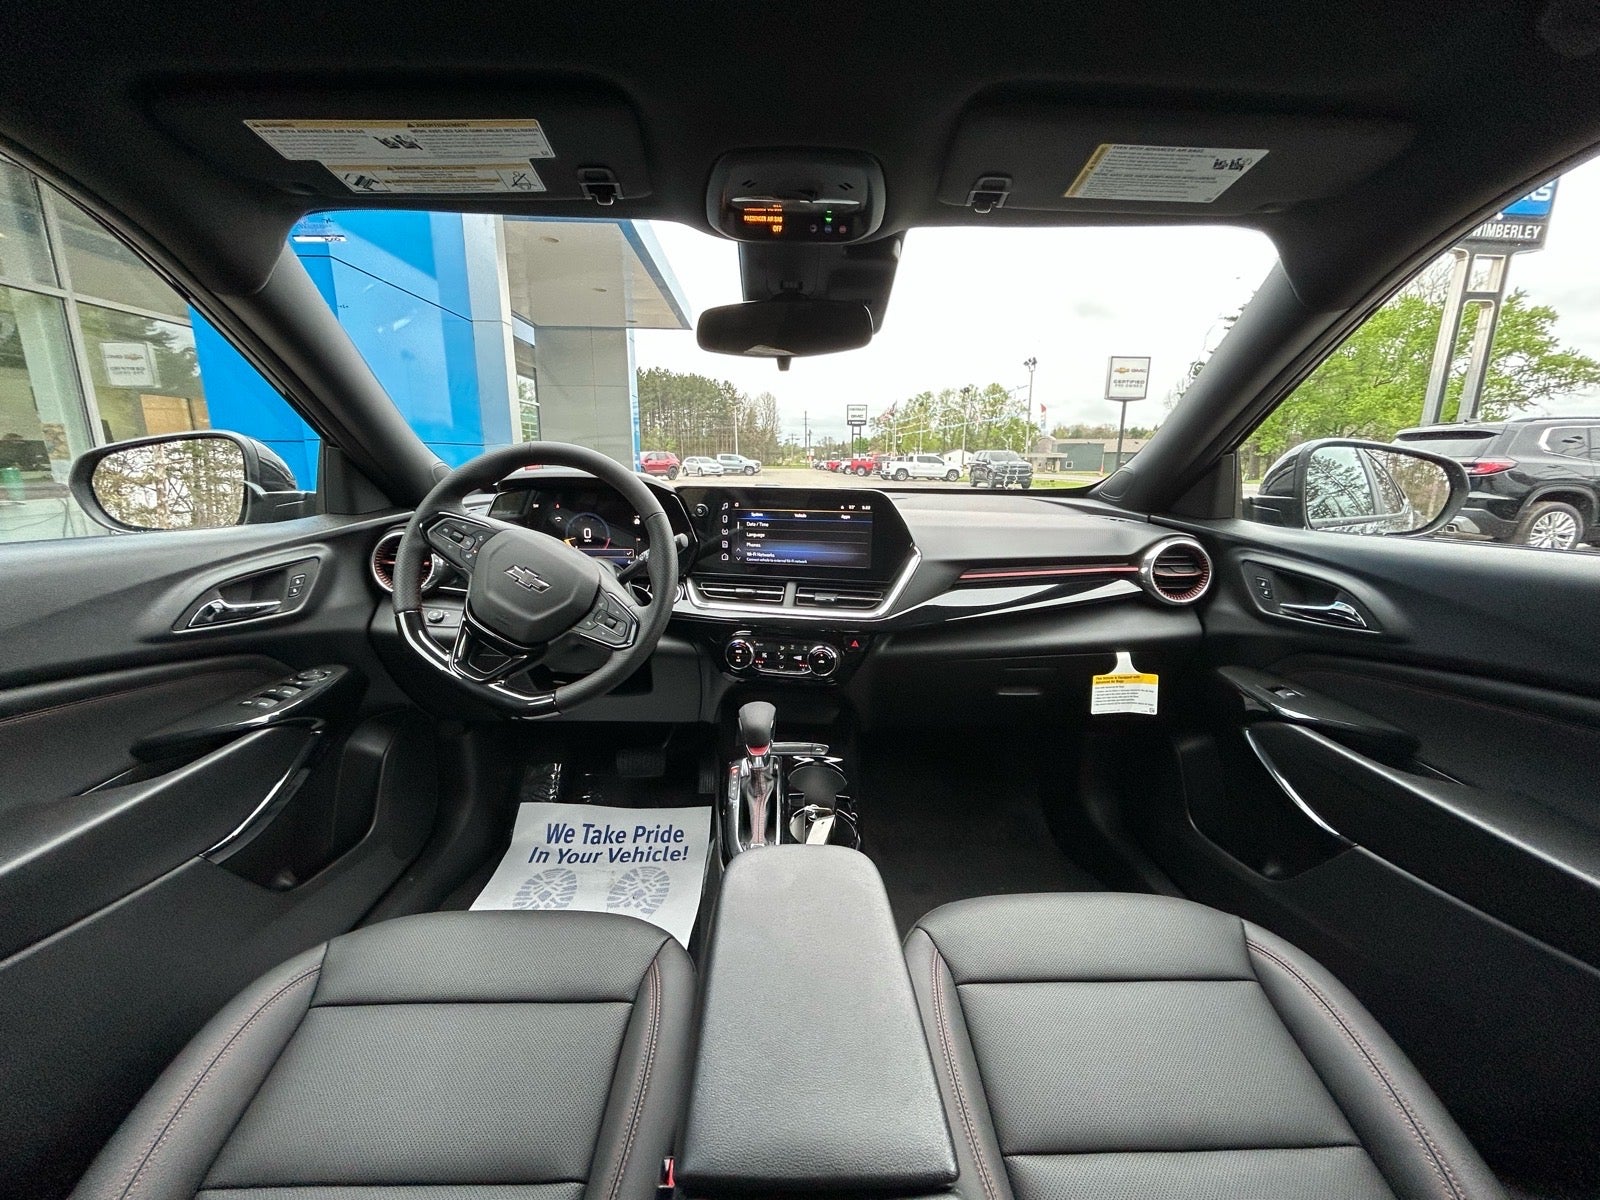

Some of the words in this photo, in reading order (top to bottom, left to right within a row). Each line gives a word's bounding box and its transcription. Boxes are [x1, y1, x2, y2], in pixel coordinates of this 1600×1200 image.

[584, 528, 592, 539] 0
[546, 823, 575, 844] We
[582, 824, 626, 845] Take
[632, 824, 684, 844] Pride
[528, 847, 550, 863] In
[557, 848, 603, 864] Your
[608, 846, 689, 863] Vehicle!
